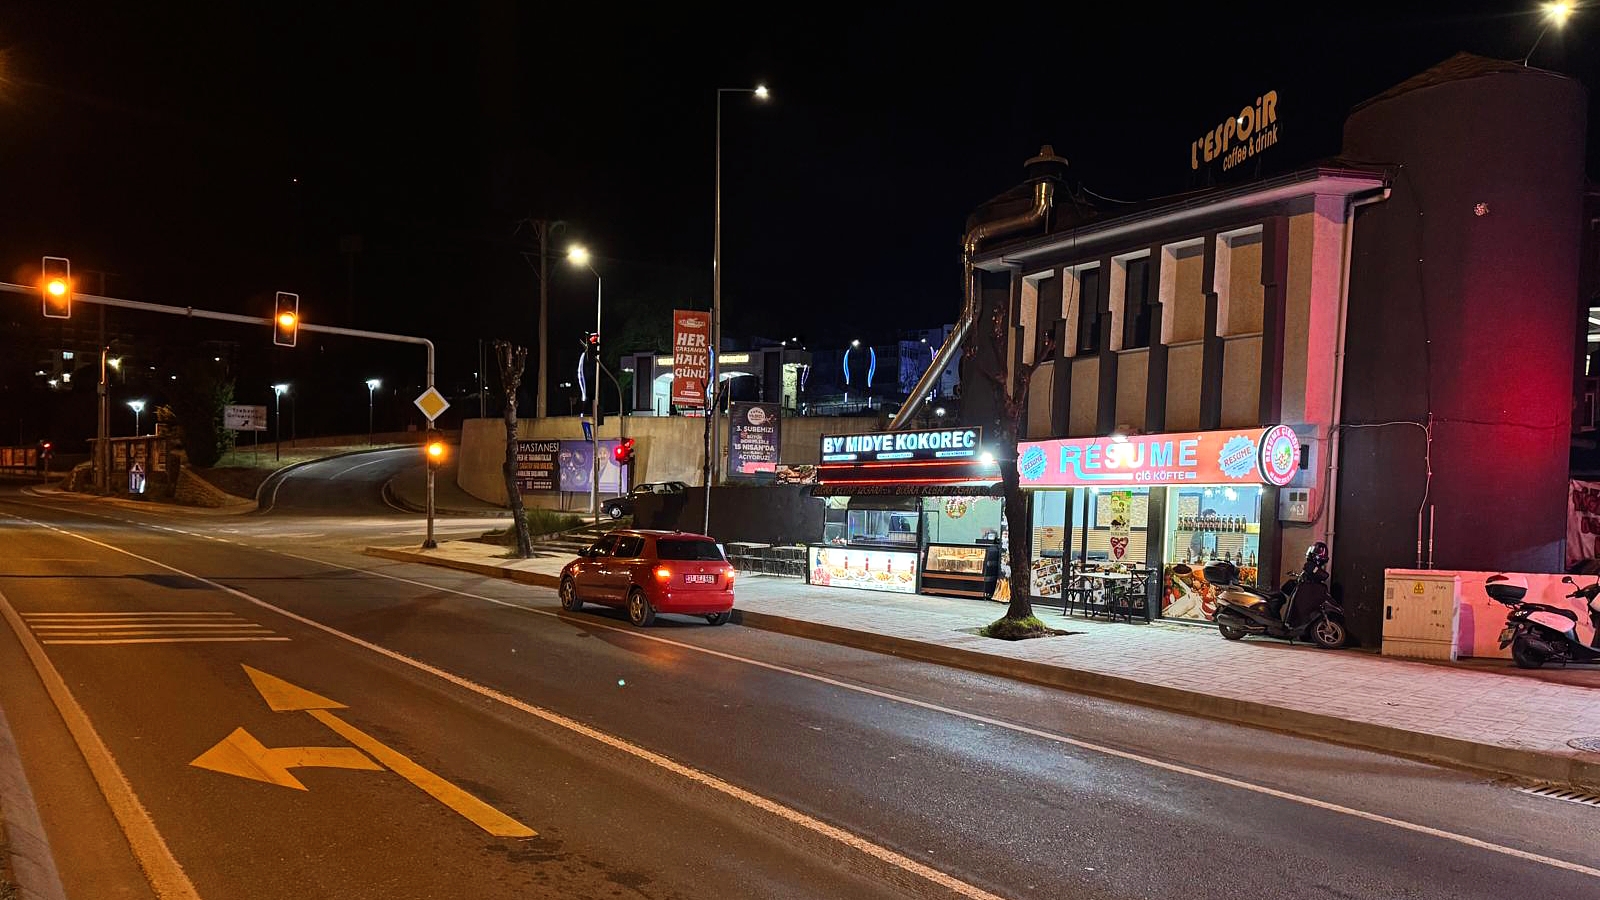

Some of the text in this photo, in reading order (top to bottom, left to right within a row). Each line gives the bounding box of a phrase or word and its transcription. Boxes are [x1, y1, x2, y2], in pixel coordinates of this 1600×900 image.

[1223, 123, 1278, 171] coffee & drink
[676, 332, 706, 347] HER
[675, 353, 706, 366] HALK
[675, 366, 706, 378] GÜNÜ
[823, 437, 844, 453] BY
[845, 434, 894, 452] MIDYE
[1060, 439, 1199, 478] RESUME
[1223, 446, 1252, 467] RESUME
[1135, 470, 1185, 482] ÇİĞ KÖFTE
